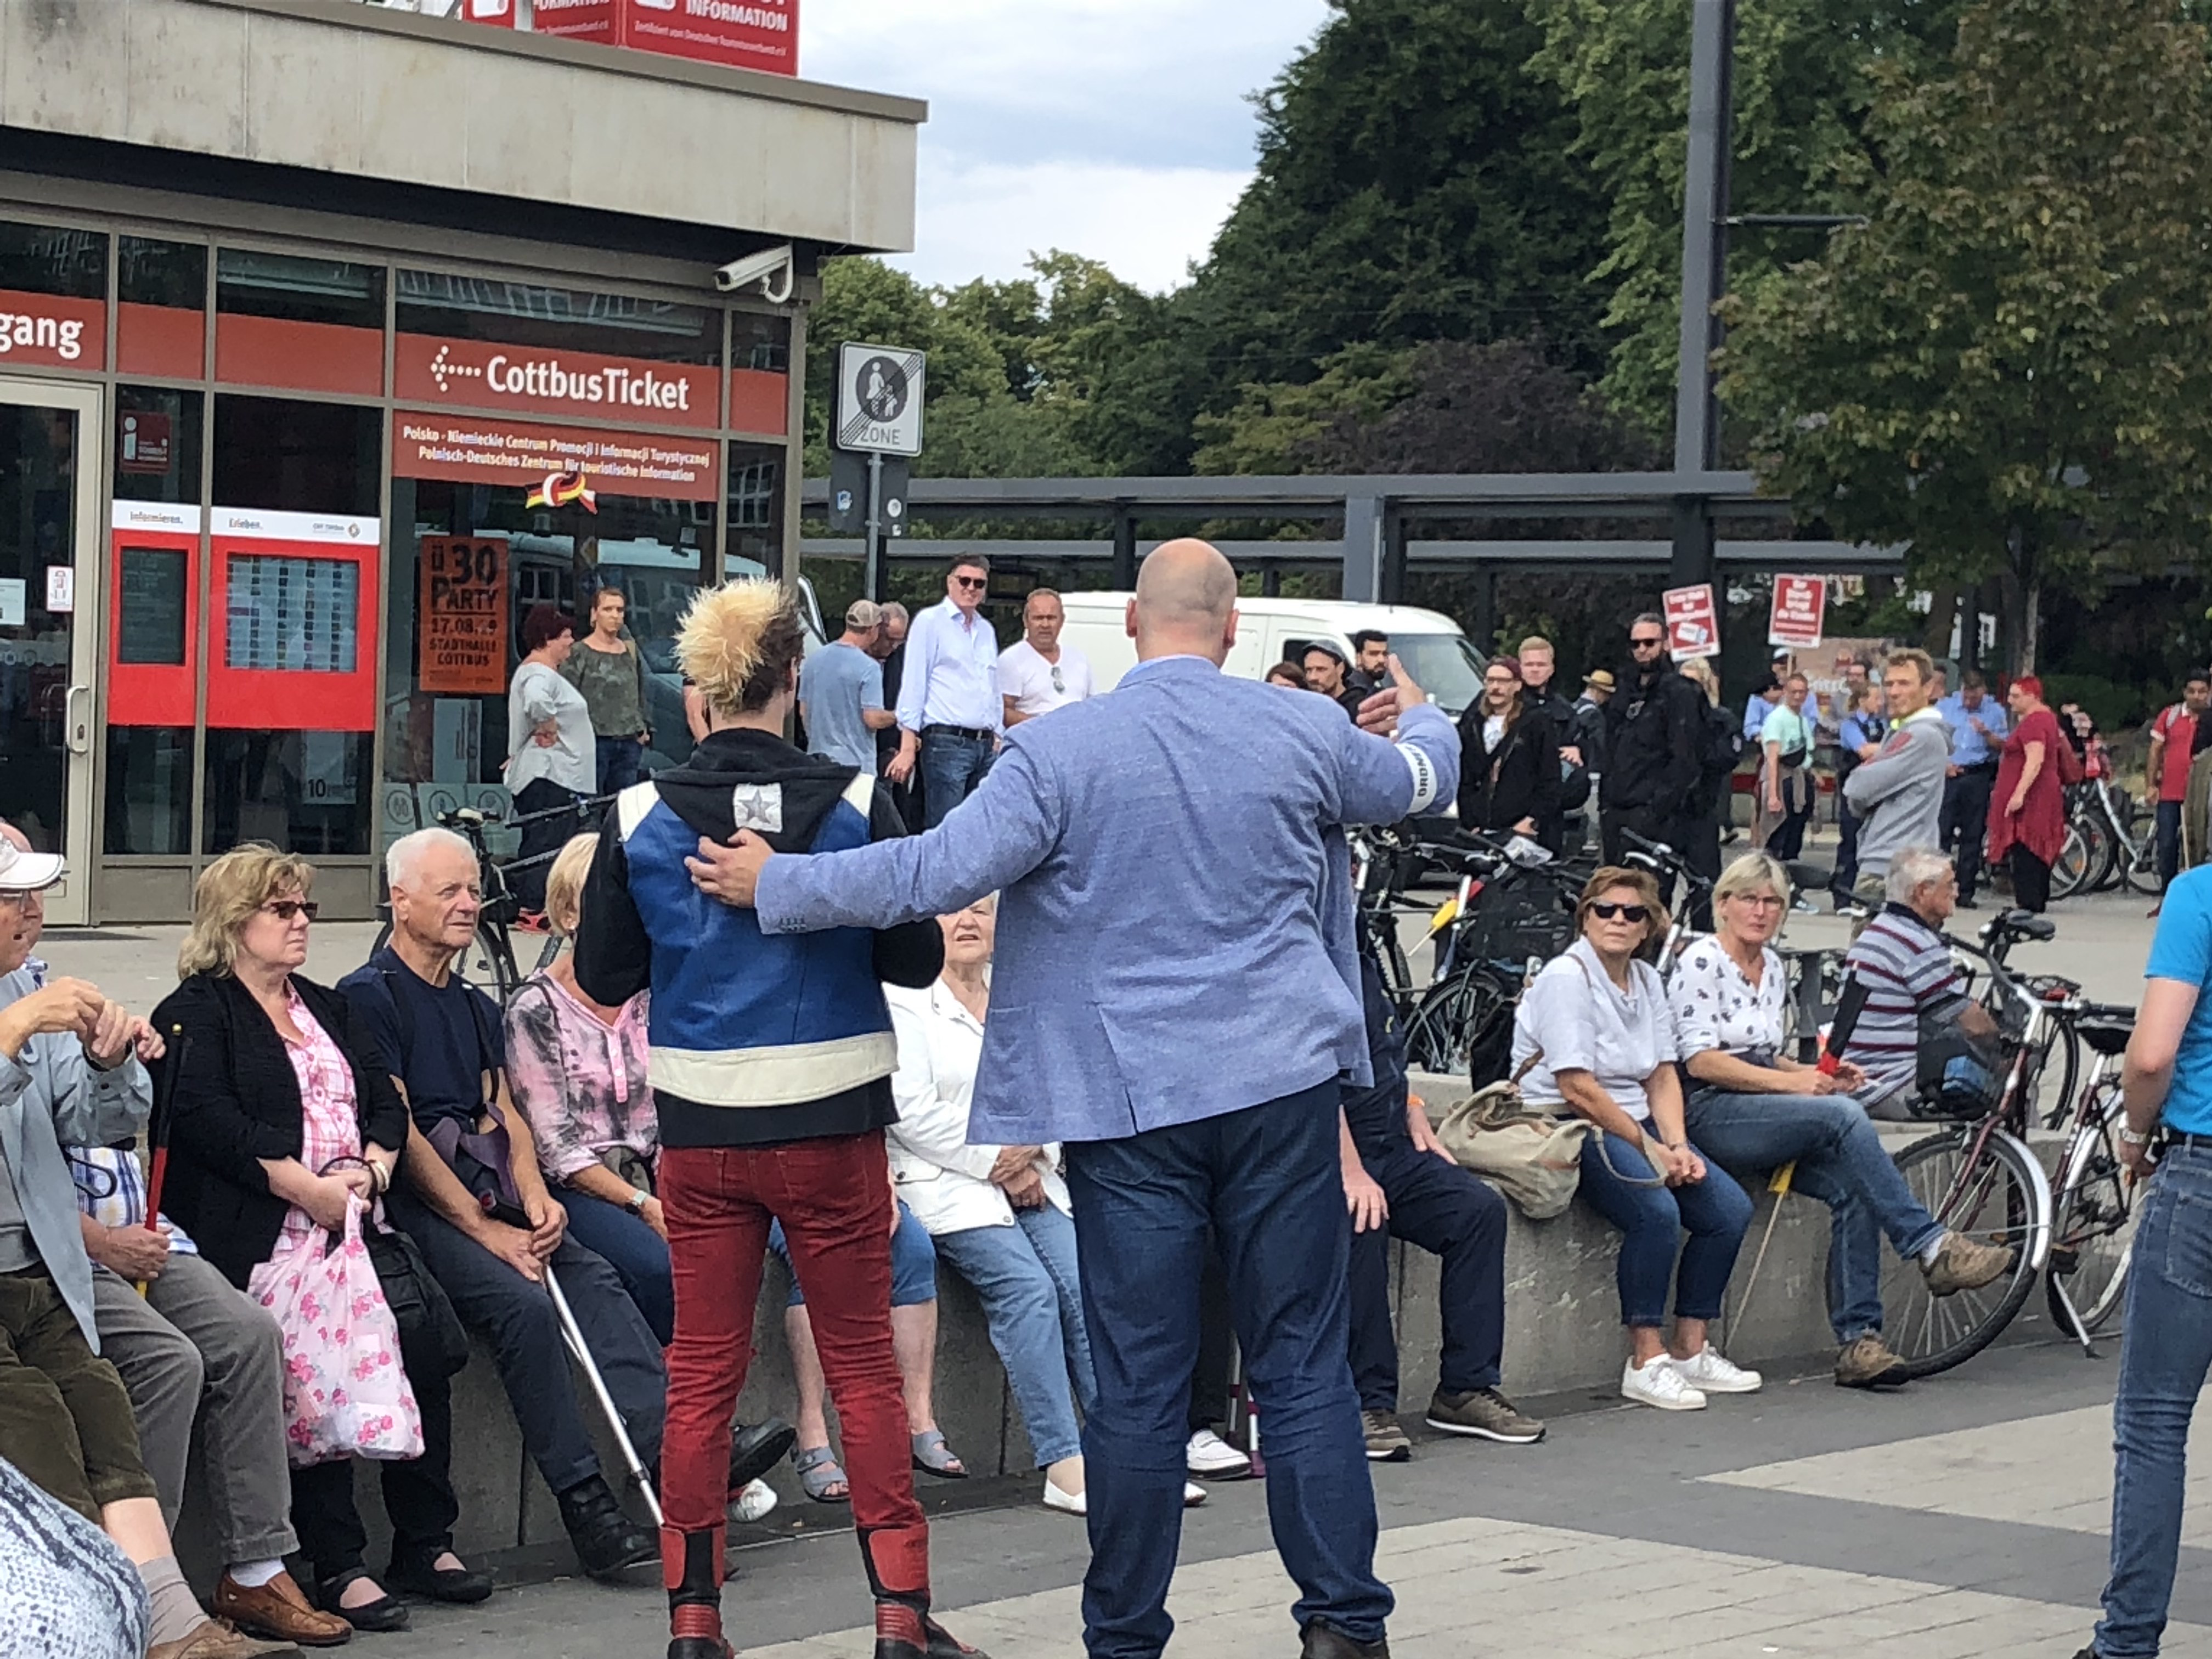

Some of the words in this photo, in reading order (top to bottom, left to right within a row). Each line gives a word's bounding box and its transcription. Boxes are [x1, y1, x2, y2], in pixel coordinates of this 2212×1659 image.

[686, 0, 787, 31] INFORMATION
[0, 312, 84, 360] gang
[487, 356, 689, 410] CottbusTicket
[448, 430, 504, 448] Niemieckie
[506, 435, 548, 451] Centrum
[550, 438, 594, 457] Promocji
[651, 448, 710, 468] Turystycznej
[860, 426, 900, 446] ZONE
[419, 446, 520, 466] Polnisch-Deutsches
[521, 455, 563, 470] Zentrum
[640, 465, 695, 482] Information
[452, 544, 497, 585] 30
[431, 577, 498, 611] PARTY
[437, 652, 490, 667] COTTBUS
[308, 779, 326, 797] 10
